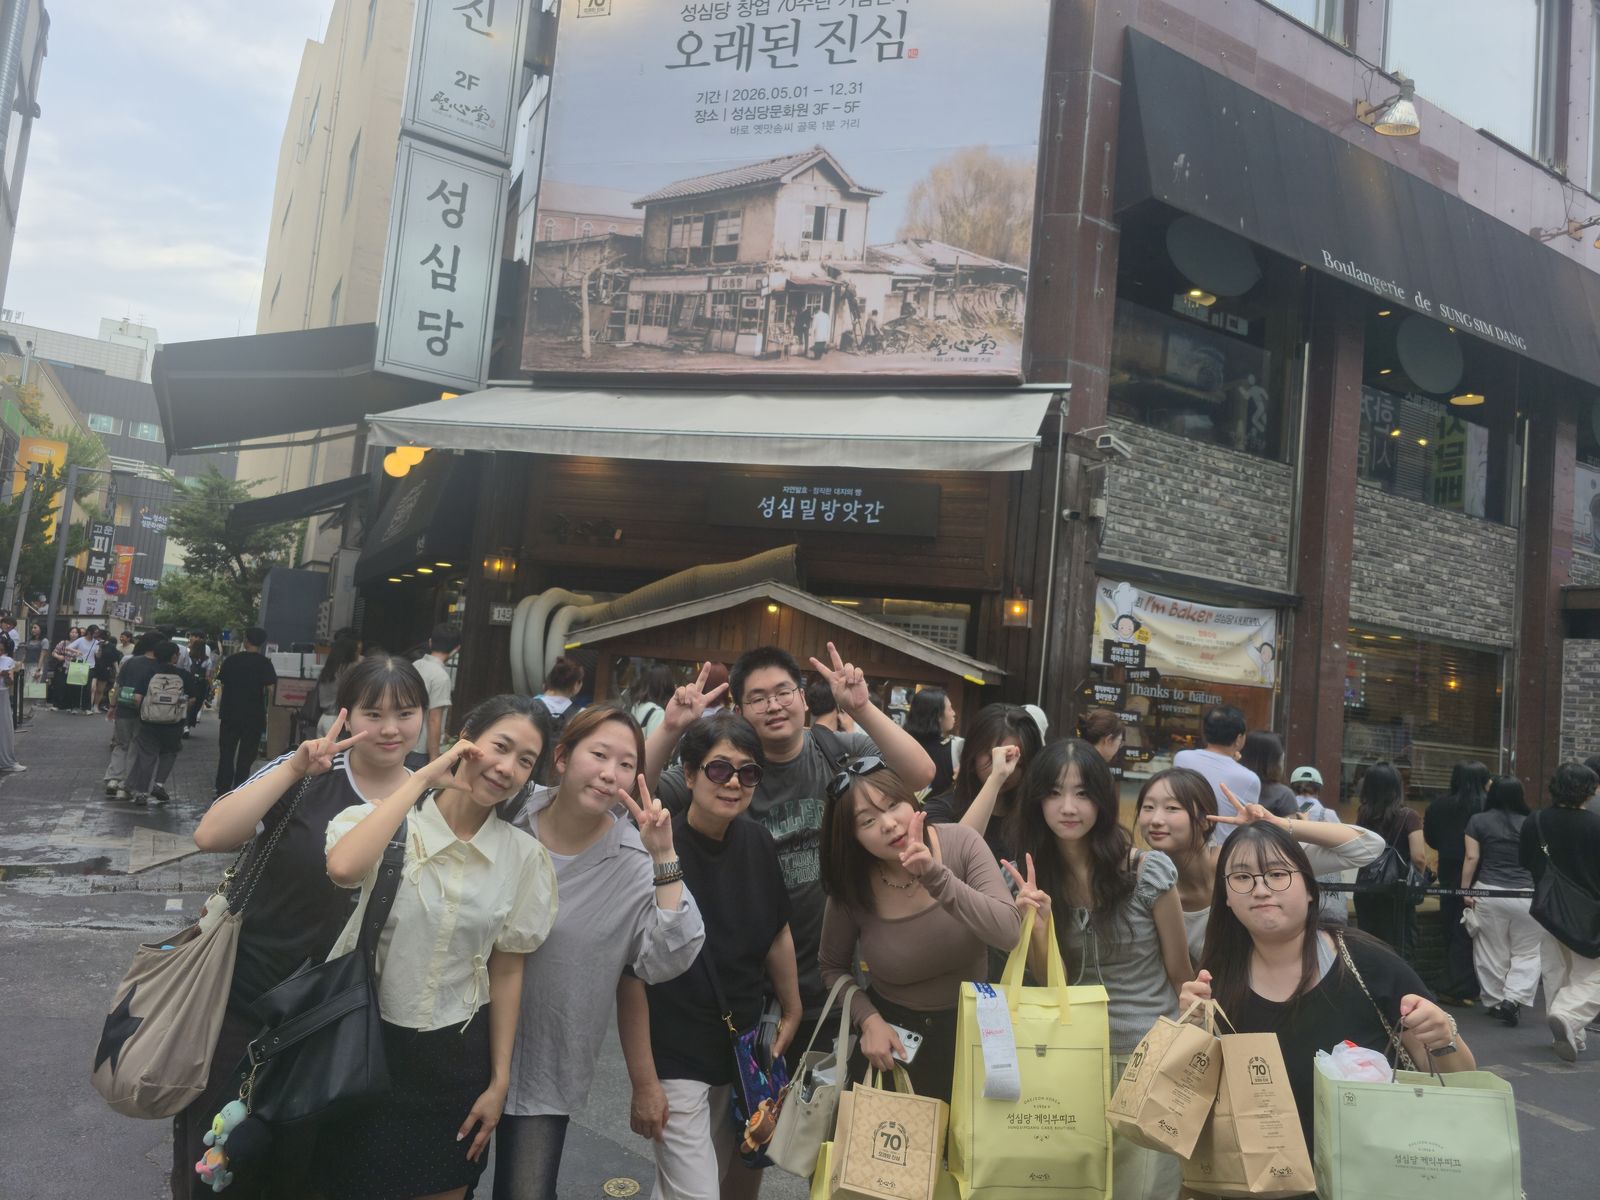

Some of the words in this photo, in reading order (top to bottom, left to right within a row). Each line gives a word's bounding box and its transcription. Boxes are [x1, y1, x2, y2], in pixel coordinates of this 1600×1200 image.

[681, 4, 732, 22] 성심당
[736, 0, 770, 18] 창업
[665, 18, 801, 72] 오래된
[815, 10, 908, 65] 진심
[454, 70, 480, 90] 2F
[696, 91, 721, 104] 기간
[732, 86, 809, 101] 2026.05.01
[829, 82, 864, 96] 12.31
[695, 109, 719, 124] 장소
[731, 103, 809, 120] 성심당문화원
[812, 102, 829, 115] 3F
[844, 100, 862, 113] 5F
[730, 126, 749, 136] 바로
[753, 122, 793, 135] 옛맛솜씨
[840, 119, 860, 129] 거리
[417, 179, 469, 357] 성심당
[1321, 249, 1406, 300] Boulangerie
[1414, 291, 1432, 311] de
[1439, 303, 1473, 328] SUNG
[1473, 318, 1495, 337] SIM
[1494, 326, 1527, 351] DANG
[757, 496, 885, 524] 성심밀방앗간
[1144, 595, 1166, 615] I'm
[1168, 603, 1214, 624] Baker
[1130, 682, 1169, 698] Thanks
[1173, 688, 1184, 700] to
[1189, 690, 1222, 705] nature
[1252, 1064, 1267, 1076] 70
[1007, 1113, 1032, 1124] 성심당
[880, 1131, 902, 1151] 70
